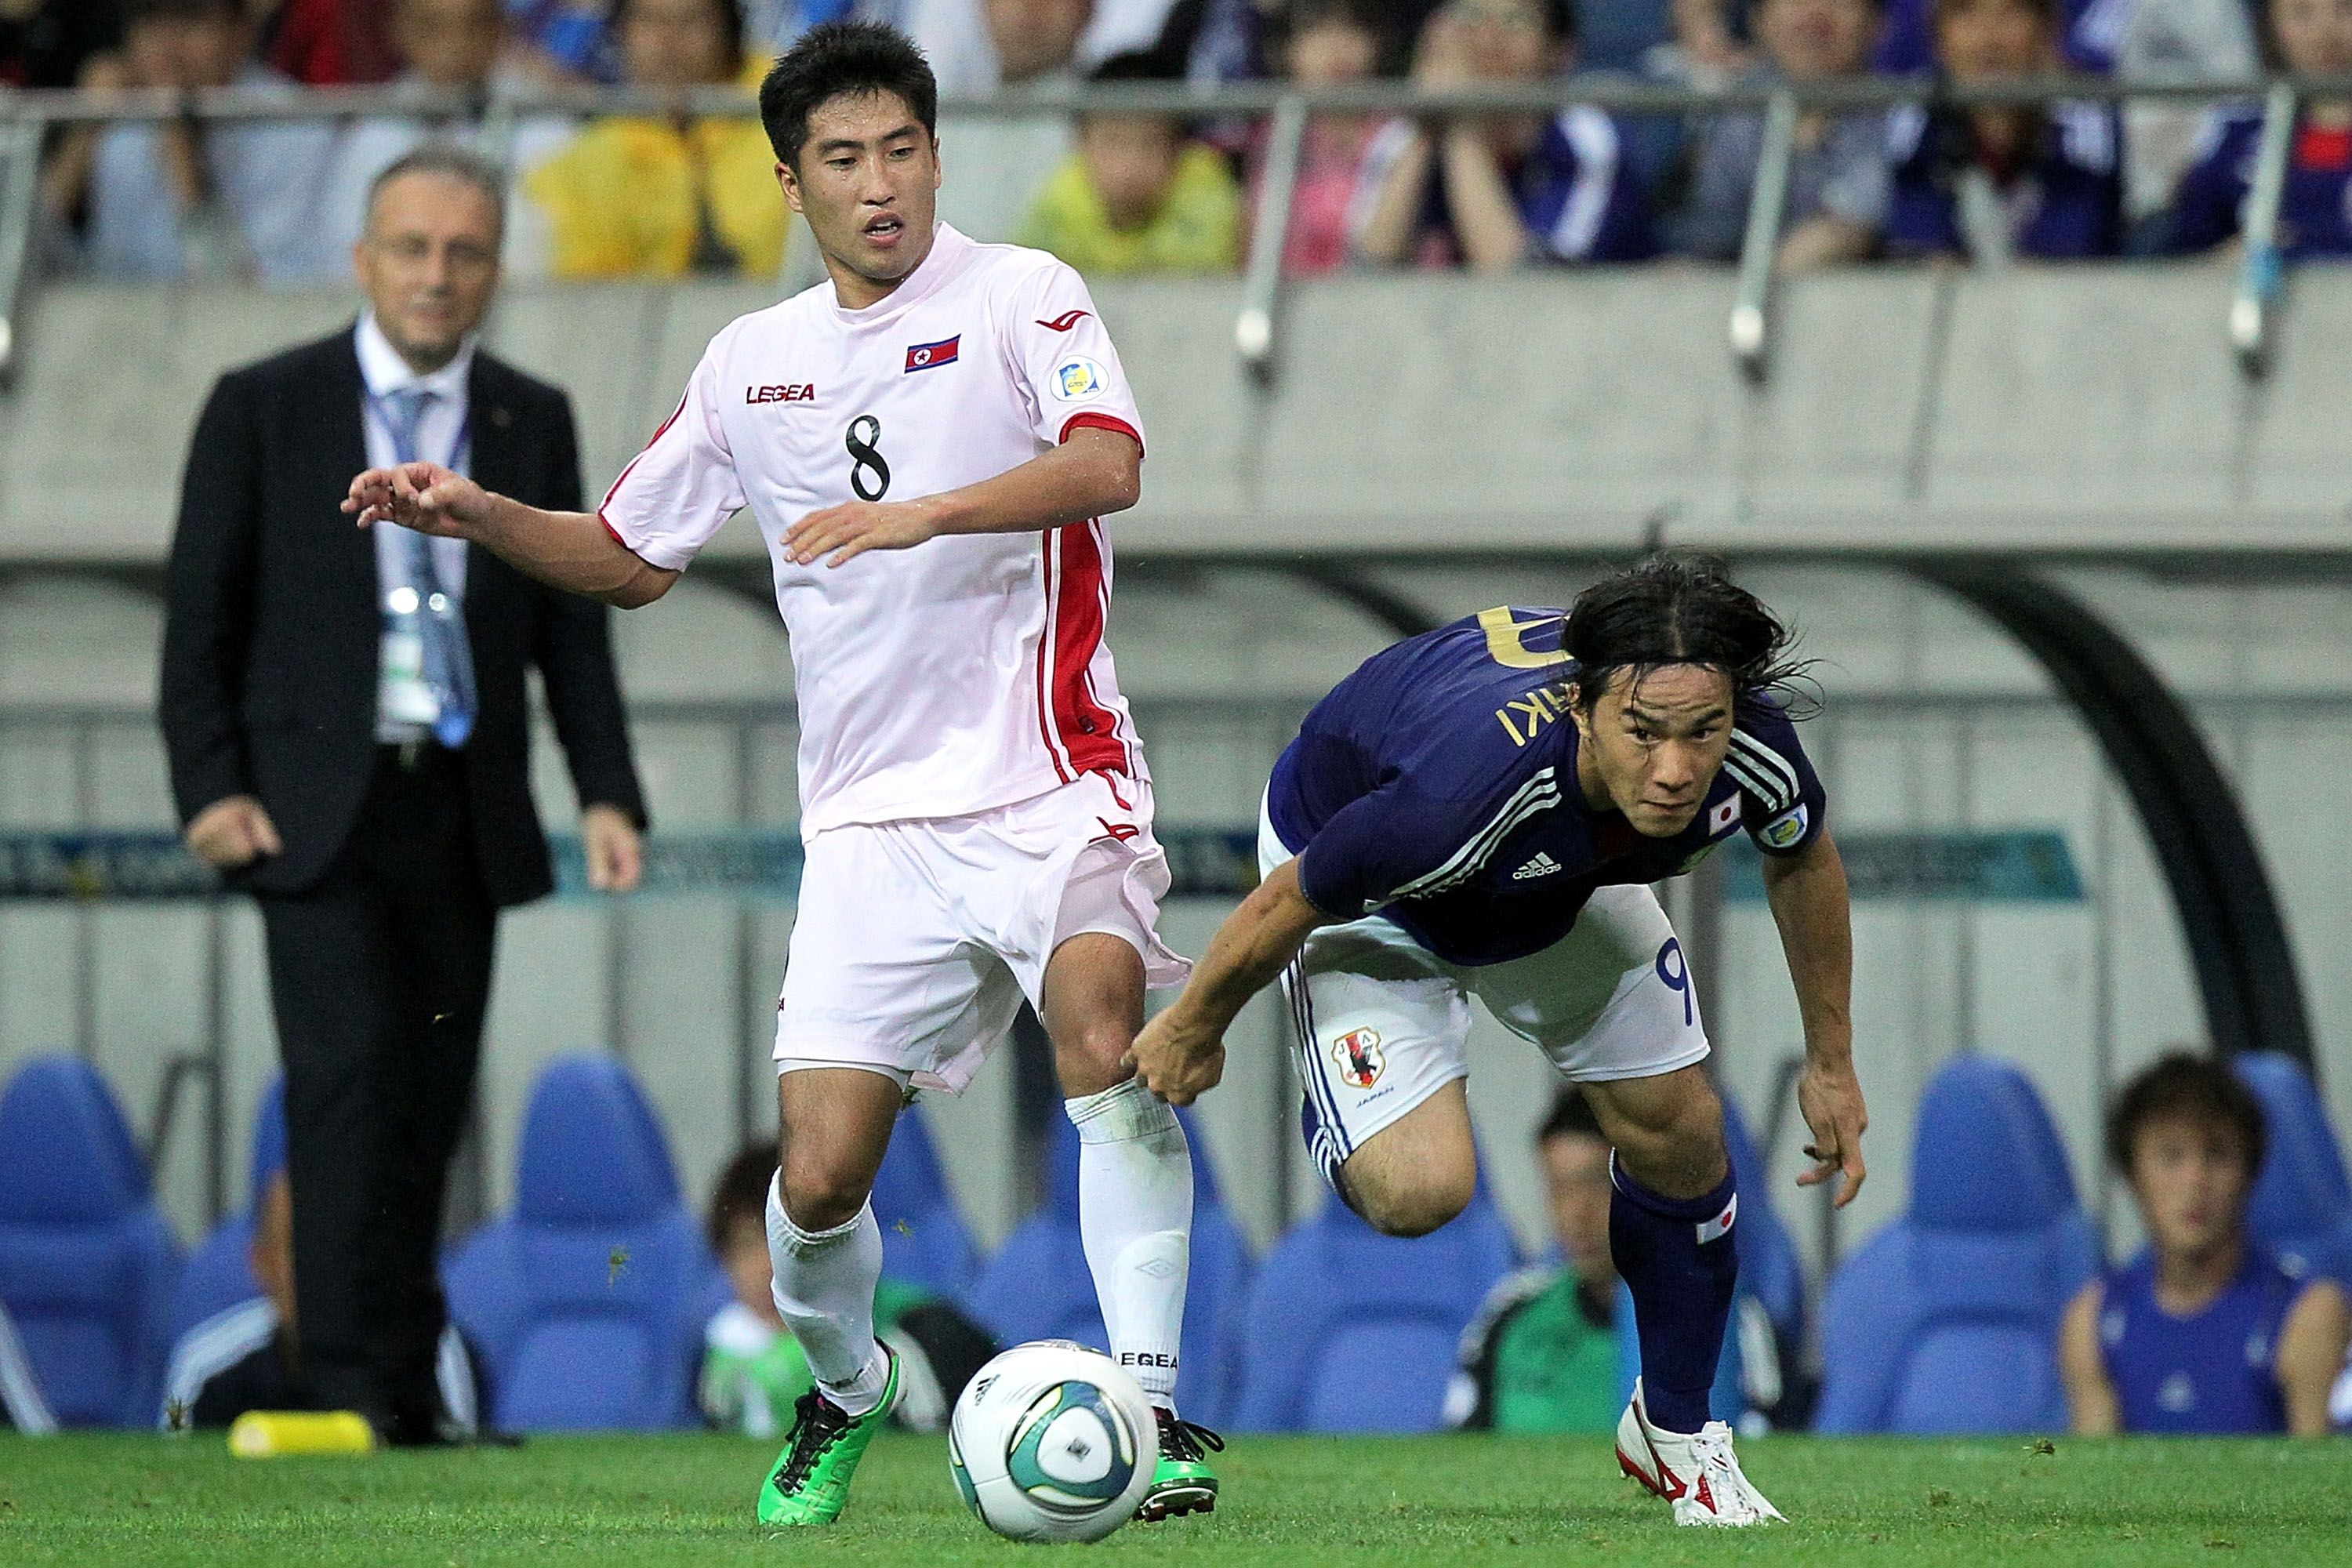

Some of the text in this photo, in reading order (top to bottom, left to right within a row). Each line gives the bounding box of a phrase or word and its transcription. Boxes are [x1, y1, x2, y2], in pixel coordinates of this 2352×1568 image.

[746, 383, 815, 405] LEGEA
[846, 415, 891, 502] 8
[1512, 863, 1562, 880] adidas
[1656, 936, 1693, 1027] 9
[1114, 1352, 1178, 1370] EGEA
